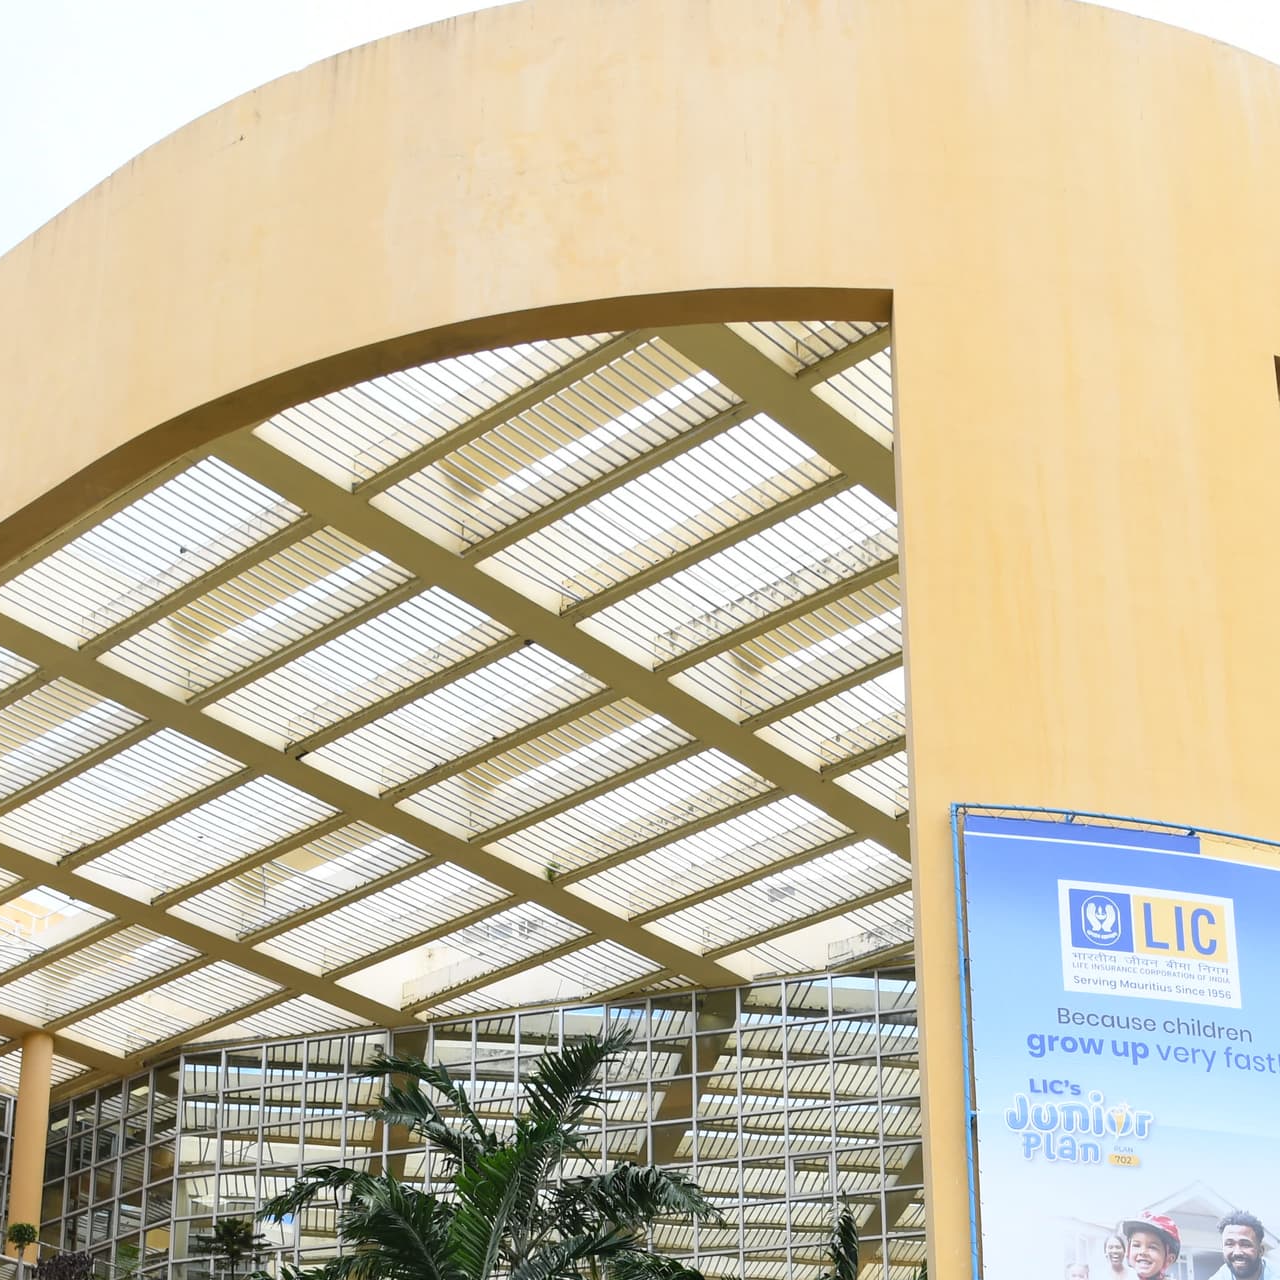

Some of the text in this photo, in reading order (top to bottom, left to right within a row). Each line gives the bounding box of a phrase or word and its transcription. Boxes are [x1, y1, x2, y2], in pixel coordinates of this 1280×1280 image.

[1143, 903, 1217, 955] LIC
[1072, 962, 1089, 970] LIFE
[1091, 964, 1137, 974] INSURANCE
[1140, 967, 1195, 980] CORPORATION
[1209, 975, 1230, 984] INDIA
[1073, 975, 1232, 1000] Serving Mauritius Since 1956
[1057, 1007, 1253, 1043] Because children
[1026, 1033, 1104, 1058] grow
[1111, 1038, 1150, 1065] up
[1156, 1043, 1217, 1073] very
[1006, 1091, 1153, 1138] Junior
[1022, 1131, 1101, 1163] Plan
[1114, 1155, 1132, 1165] 702
